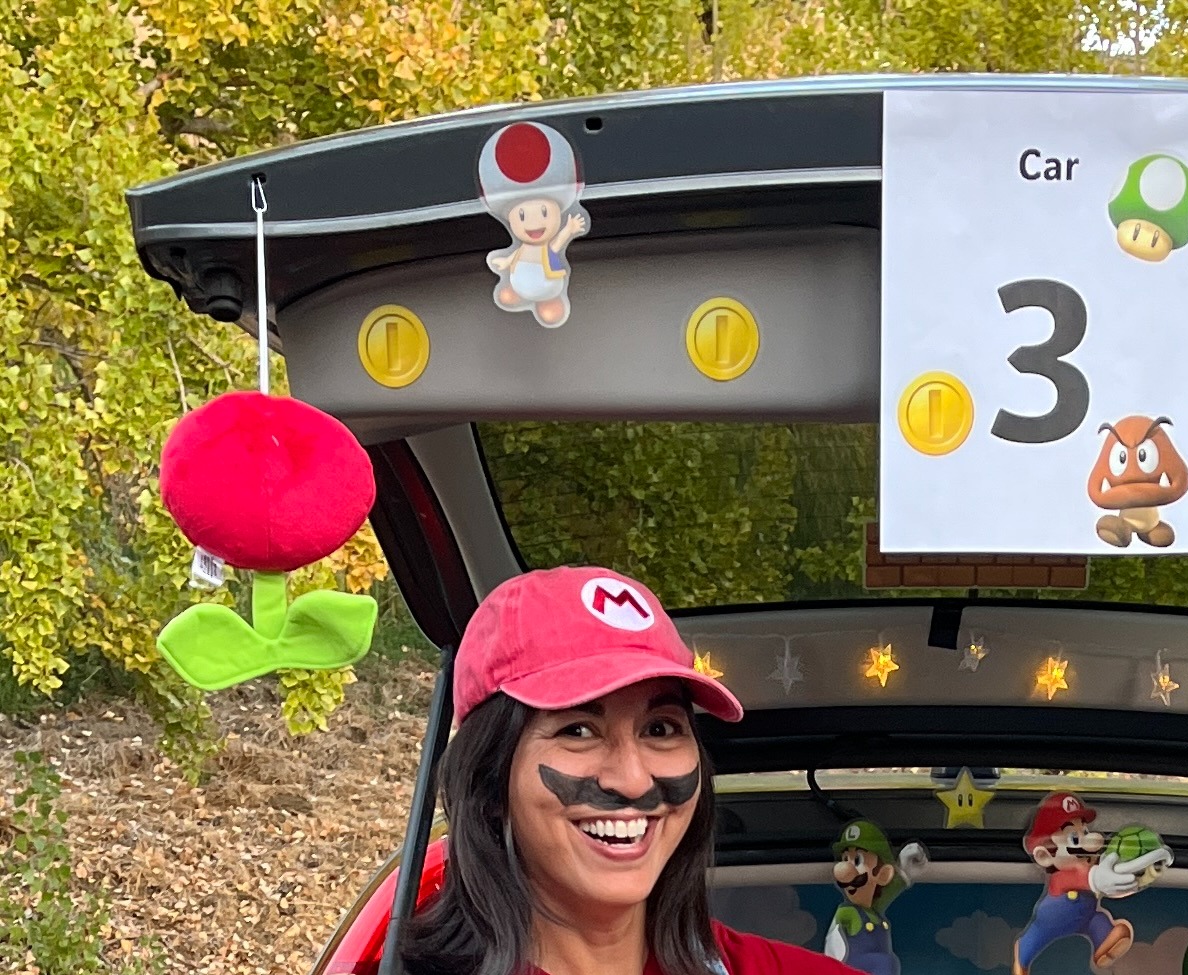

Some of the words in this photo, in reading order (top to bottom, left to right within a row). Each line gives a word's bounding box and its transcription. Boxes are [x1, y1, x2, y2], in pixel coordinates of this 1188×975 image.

[1018, 148, 1080, 182] Car
[991, 278, 1090, 444] 3
[592, 585, 650, 618] M
